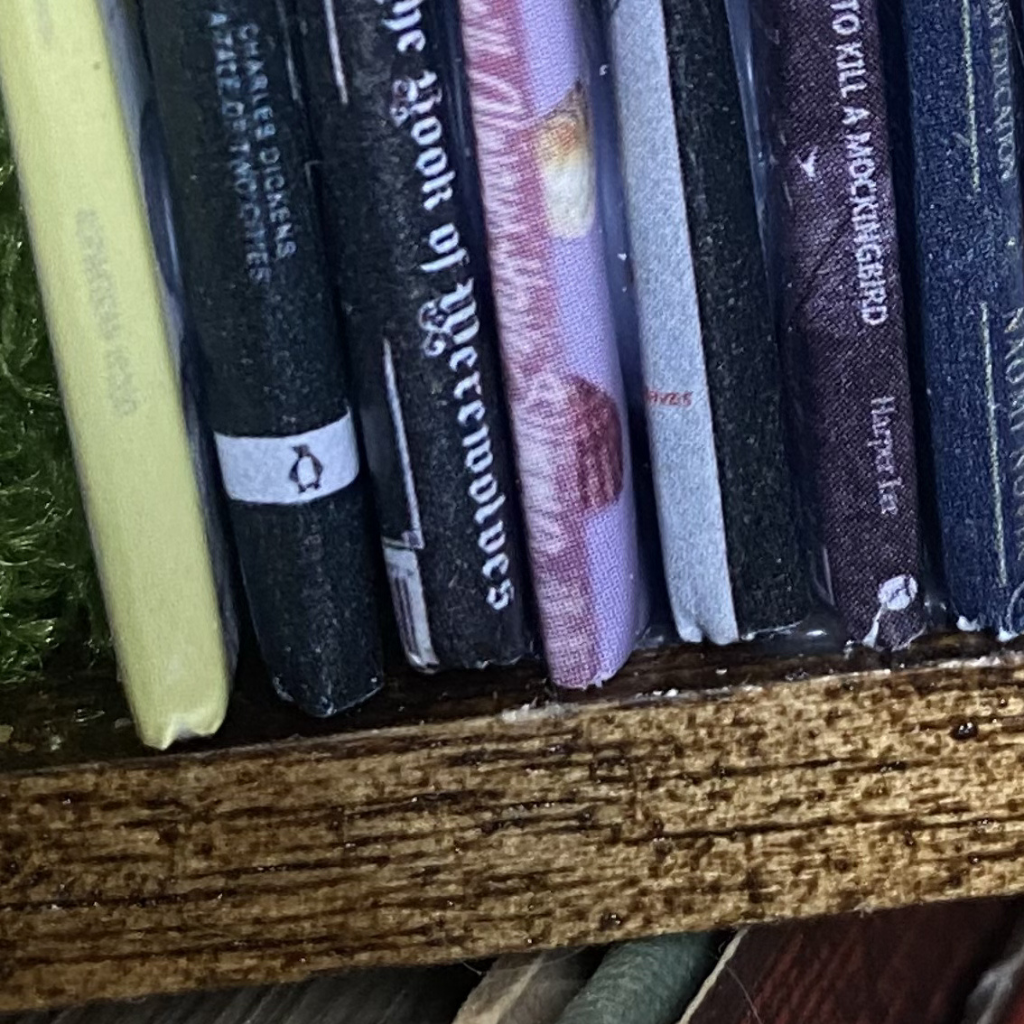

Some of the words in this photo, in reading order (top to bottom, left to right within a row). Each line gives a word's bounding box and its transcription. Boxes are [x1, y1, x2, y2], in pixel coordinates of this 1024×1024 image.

[836, 42, 868, 98] KILL
[842, 106, 871, 125] A
[239, 24, 277, 140] CHARLES
[259, 146, 297, 260] DICKENS
[389, 70, 456, 211] Book
[420, 223, 470, 272] of
[846, 132, 888, 326] MOCKINGBIRD
[419, 278, 515, 610] Werewolves
[868, 396, 896, 474] Harper
